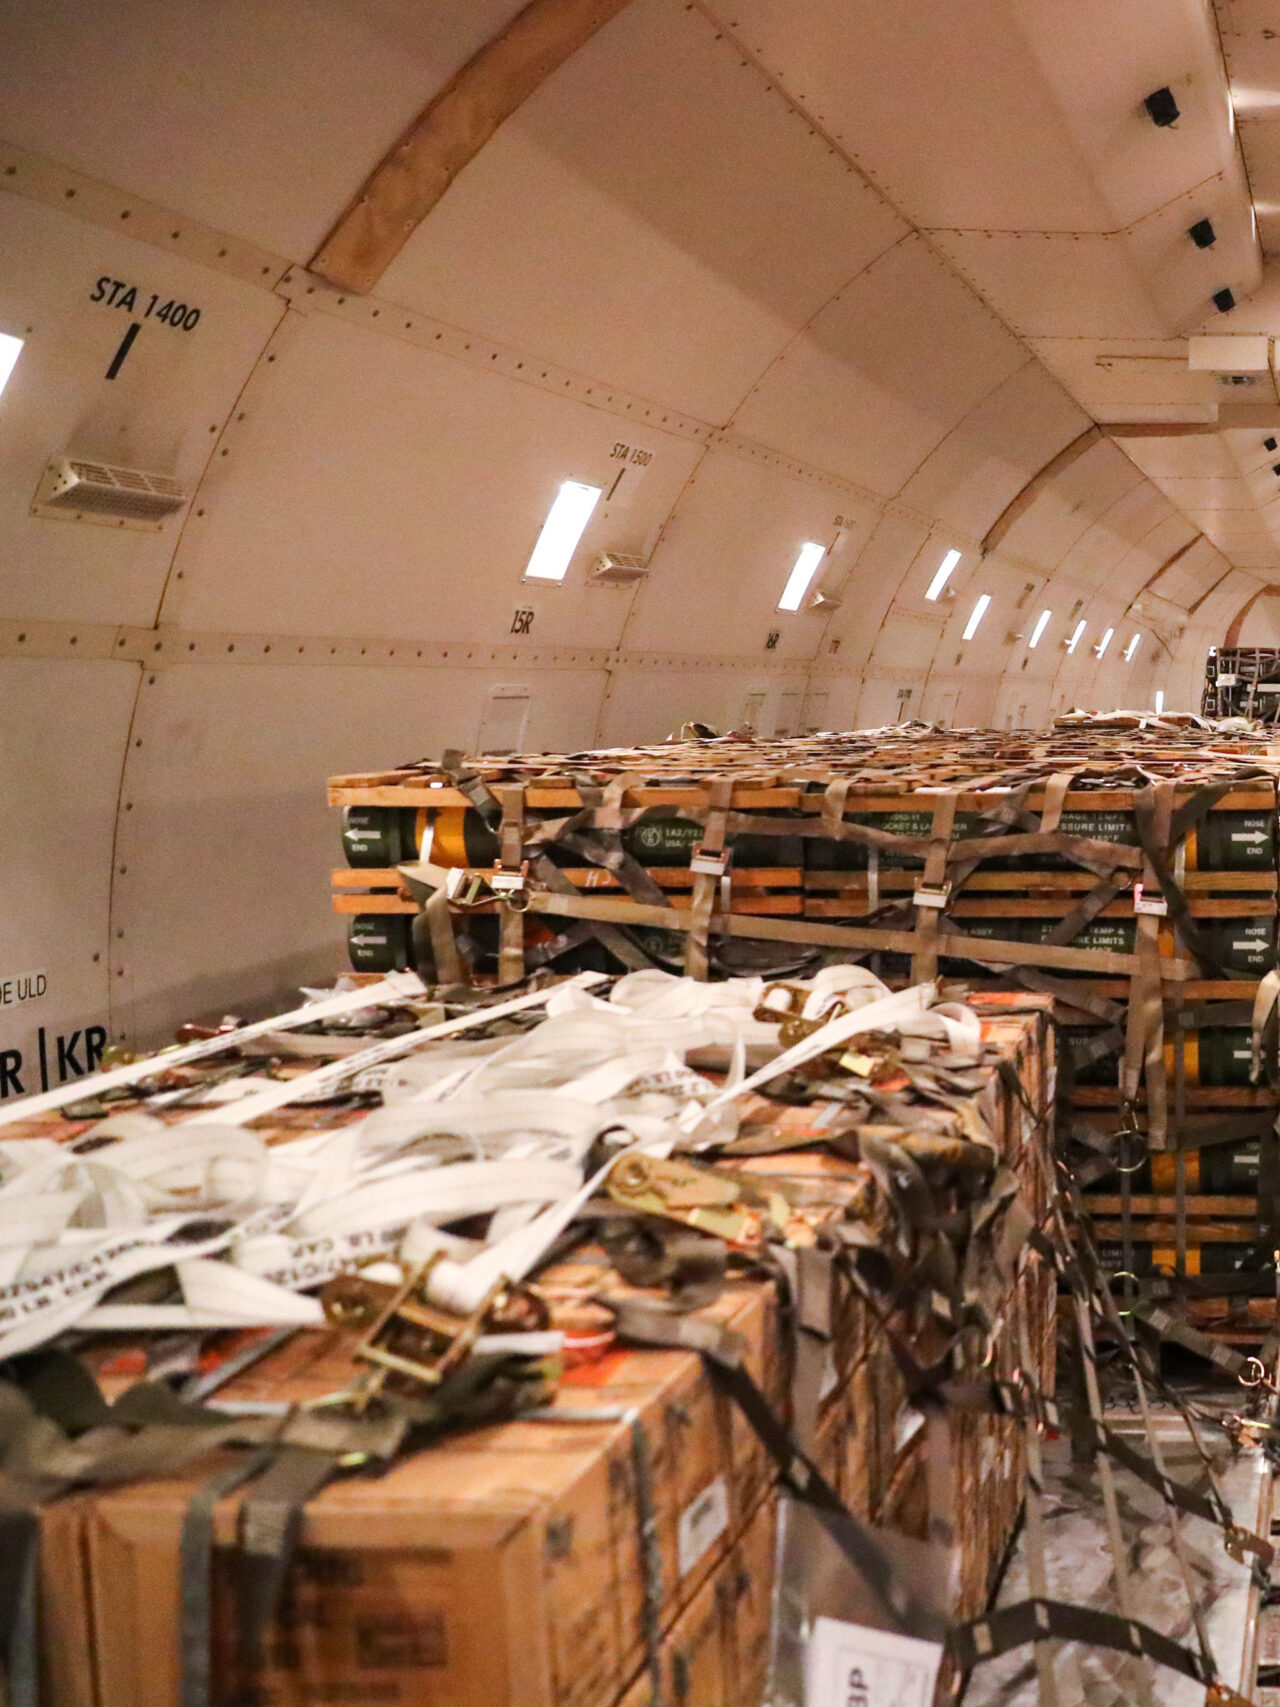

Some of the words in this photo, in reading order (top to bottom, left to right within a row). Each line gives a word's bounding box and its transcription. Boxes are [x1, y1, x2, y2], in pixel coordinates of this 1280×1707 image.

[90, 276, 137, 313] STA
[144, 294, 201, 332] 1400
[609, 442, 628, 461] STA
[629, 448, 653, 467] 1500
[510, 609, 535, 635] 15R
[1098, 823, 1132, 832] LIMITS
[1244, 820, 1265, 828] NOSE
[1246, 847, 1263, 855] END
[1245, 928, 1267, 936] NOSE
[1093, 936, 1125, 945] LIMITS
[1247, 955, 1264, 963] END
[17, 974, 47, 1001] ULD
